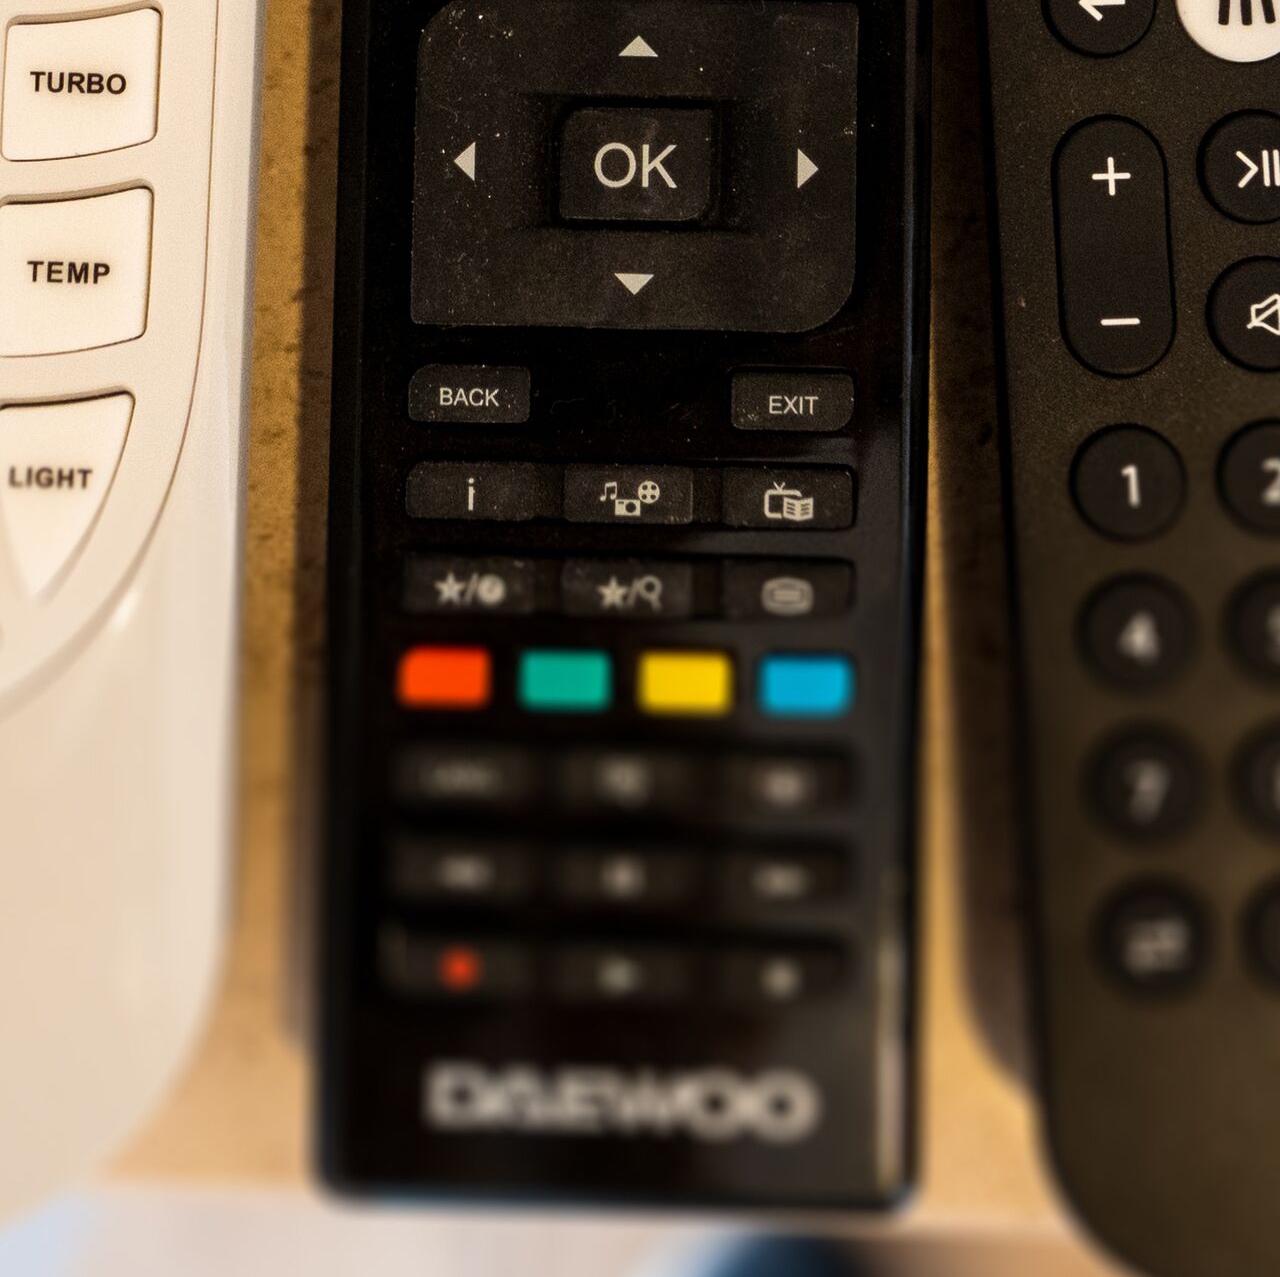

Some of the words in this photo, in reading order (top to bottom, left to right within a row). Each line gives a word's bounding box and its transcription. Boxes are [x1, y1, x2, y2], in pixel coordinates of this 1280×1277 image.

[29, 70, 128, 97] TURBO
[593, 141, 679, 189] OK
[26, 260, 112, 286] TEMP
[438, 386, 500, 407] BACK
[768, 394, 820, 415] EXIT
[7, 465, 94, 491] LIGHT
[1121, 464, 1141, 507] 1
